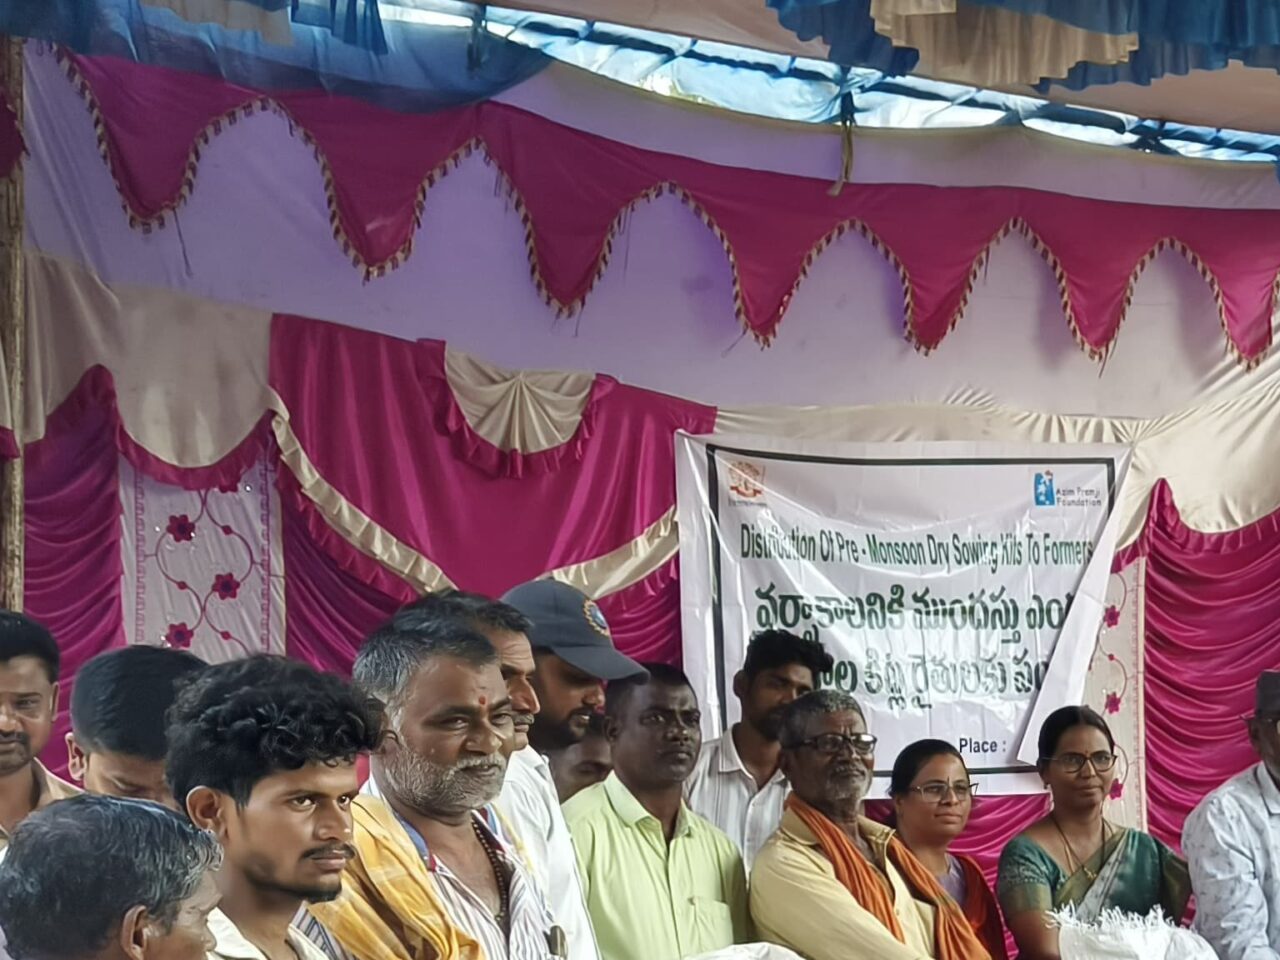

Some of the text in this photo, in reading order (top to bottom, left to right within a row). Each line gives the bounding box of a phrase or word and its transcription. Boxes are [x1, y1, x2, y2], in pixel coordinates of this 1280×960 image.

[1056, 487, 1075, 497] Azim
[1056, 497, 1102, 507] Foundation
[820, 529, 834, 562] Of
[836, 531, 859, 563] Pre
[866, 533, 926, 566] Monsoon
[927, 533, 950, 573] Dry
[952, 532, 998, 574] Sowing
[1000, 532, 1022, 566] Kits
[1026, 532, 1040, 566] To
[959, 737, 998, 753] Place
